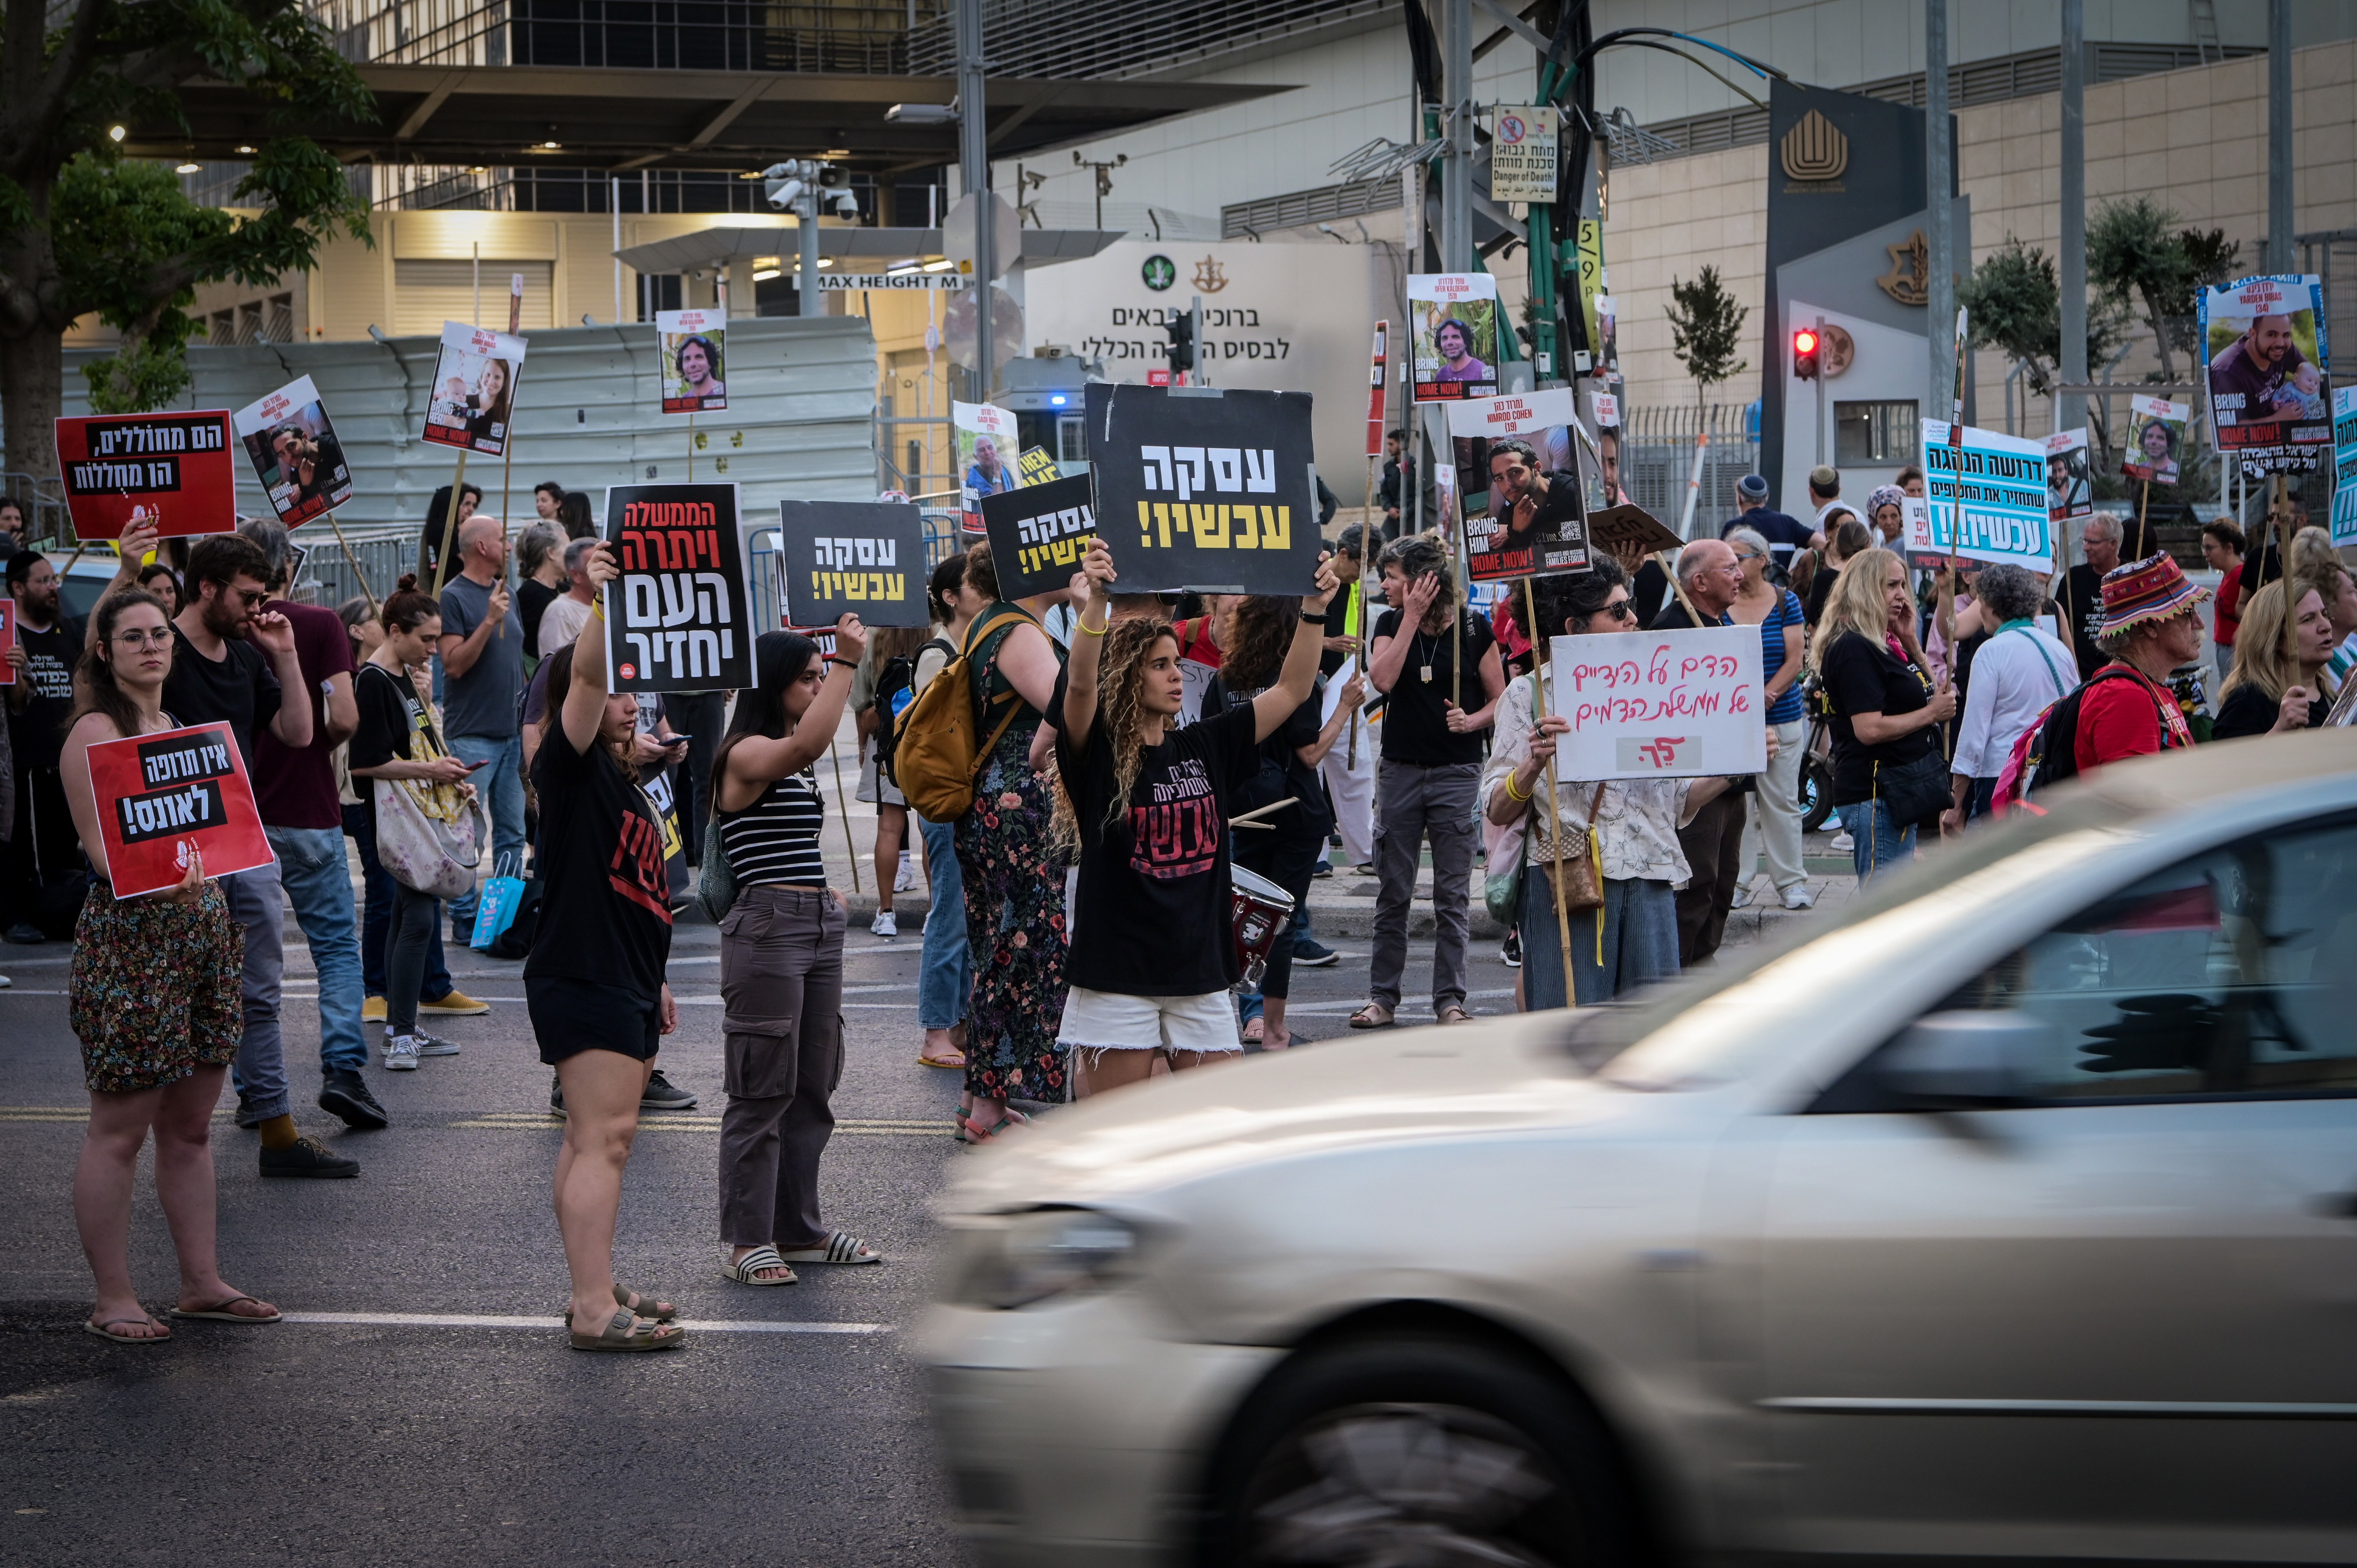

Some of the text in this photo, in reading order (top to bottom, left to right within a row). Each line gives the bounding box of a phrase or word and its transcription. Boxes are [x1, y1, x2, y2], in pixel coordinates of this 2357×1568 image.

[1531, 145, 1554, 156] מתח
[1494, 158, 1554, 169] סכנת מוות!
[1494, 170, 1555, 184] Danger of Death!
[860, 276, 932, 288] HEIGHT
[941, 277, 958, 288] M
[2239, 292, 2283, 304] YARDEN BIBAS
[1113, 308, 1260, 327] ברוכי באים
[2256, 304, 2269, 314] (34)
[1083, 337, 1144, 358] הכללי
[1224, 337, 1289, 359] לבסיס
[1415, 358, 1439, 370] BRING
[1416, 371, 1431, 383] HIM
[1417, 381, 1462, 396] HOME NOW!
[260, 398, 290, 418] NIMROD COHEN
[431, 401, 454, 415] BRING
[1494, 399, 1523, 412] נמרוד כהן
[2214, 392, 2246, 410] BRING
[428, 413, 443, 425] HER
[1487, 409, 1532, 423] NIMROD COHEN
[2216, 410, 2237, 426] HIM
[192, 425, 221, 449] הם
[426, 424, 472, 443] HOME NOW!
[1505, 422, 1517, 433] (19)
[2219, 421, 2281, 443] HOME NOW!
[1019, 449, 1051, 475] THEM
[1988, 455, 2043, 482] דרושה
[148, 462, 172, 486] הן
[1141, 445, 1276, 500] עסקה
[269, 481, 293, 502] BRING
[962, 487, 979, 501] BRING
[1984, 487, 2001, 503] את
[2003, 489, 2045, 508] שתחזיר
[274, 497, 292, 514] HIM
[281, 507, 304, 524] HOME
[302, 493, 326, 515] NOW!
[624, 501, 716, 526] הממשלה
[962, 499, 972, 512] HIM
[1018, 504, 1095, 544] עסקה
[1138, 501, 1290, 549] עכשיו!
[1466, 517, 1498, 536] BRING
[1938, 505, 2042, 556] עכשיו!!!
[622, 530, 721, 570] ויתרה
[815, 537, 895, 571] עסקה
[1018, 533, 1096, 574] כשיו!
[1469, 536, 1489, 554] HIM
[1472, 547, 1534, 572] HOME NOW!
[1546, 554, 1585, 567] FAMILIES FORUM
[812, 571, 904, 600] עכשיו!
[624, 573, 731, 627] העם
[625, 629, 733, 680] יחזיר
[32, 670, 69, 683] כפדי
[1573, 645, 1738, 692] הדם על הידיים
[37, 685, 72, 698] שבוי
[1576, 684, 1749, 733] של ממשלת הדמים
[145, 743, 228, 783] אין תרופה
[123, 784, 209, 835] לאונס!
[1128, 794, 1220, 862] עכשי
